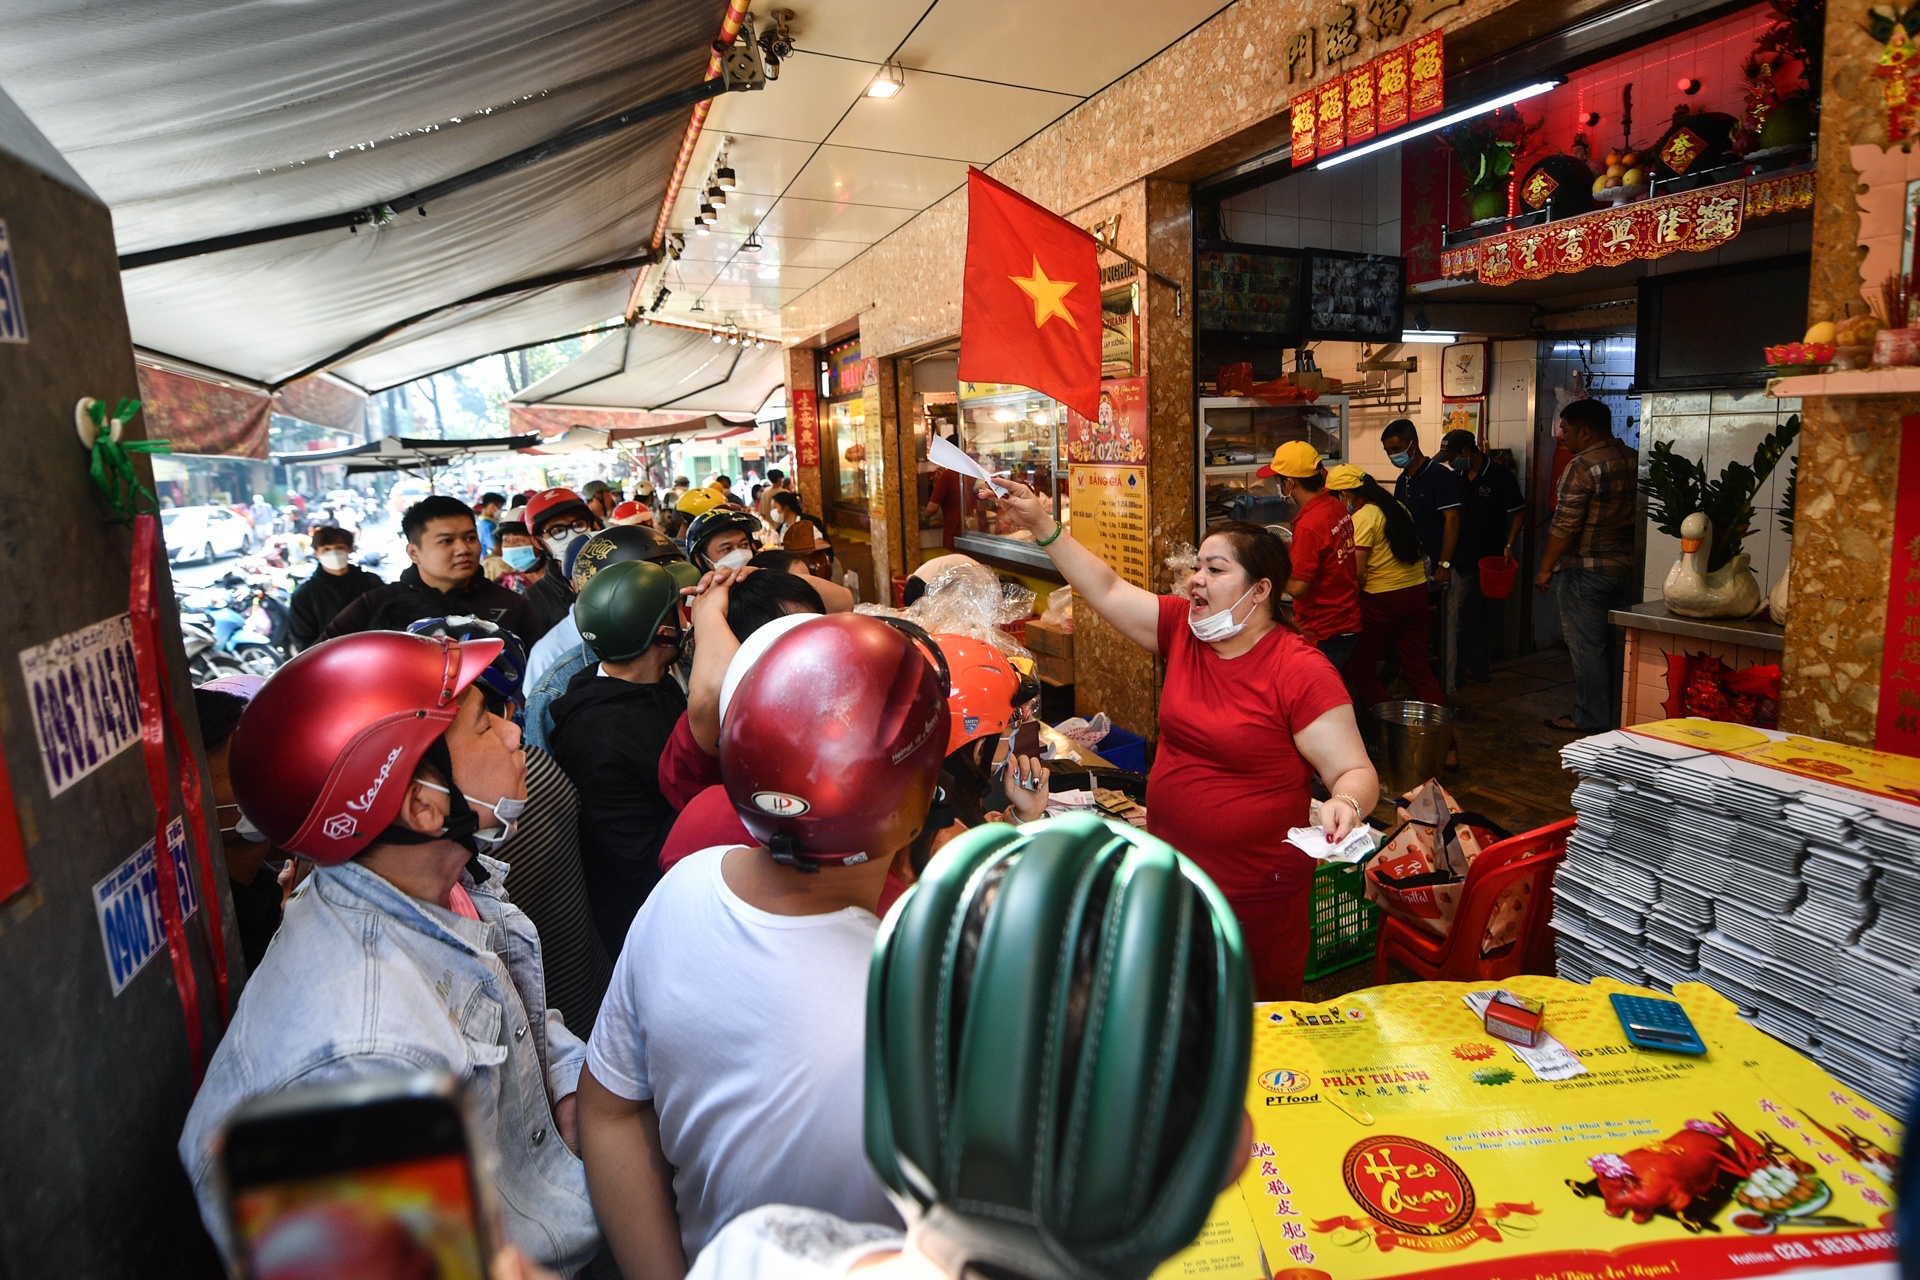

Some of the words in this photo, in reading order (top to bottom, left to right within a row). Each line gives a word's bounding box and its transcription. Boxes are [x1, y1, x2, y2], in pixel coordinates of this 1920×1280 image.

[1378, 57, 1406, 95] 福
[1412, 40, 1441, 81] 福
[1319, 86, 1343, 122] 福
[1348, 72, 1374, 109] 福
[1292, 99, 1316, 134] 福
[1450, 410, 1469, 432] 31
[1089, 441, 1121, 461] 2023
[1089, 472, 1108, 486] BẢNG
[1109, 475, 1122, 487] GIÁ
[346, 746, 402, 813] Vespa
[1320, 1073, 1366, 1088] PHÁT
[1369, 1070, 1430, 1084] THÀNH
[1554, 1083, 1574, 1091] CHO
[1266, 1096, 1284, 1106] PT
[1286, 1094, 1318, 1103] food
[1481, 1128, 1510, 1138] PHÁT
[1363, 1148, 1440, 1184] Heo
[1250, 1142, 1316, 1264] 馳名脆皮肥鴨
[1381, 1180, 1457, 1214] Quay
[1438, 1229, 1479, 1248] THÀNH
